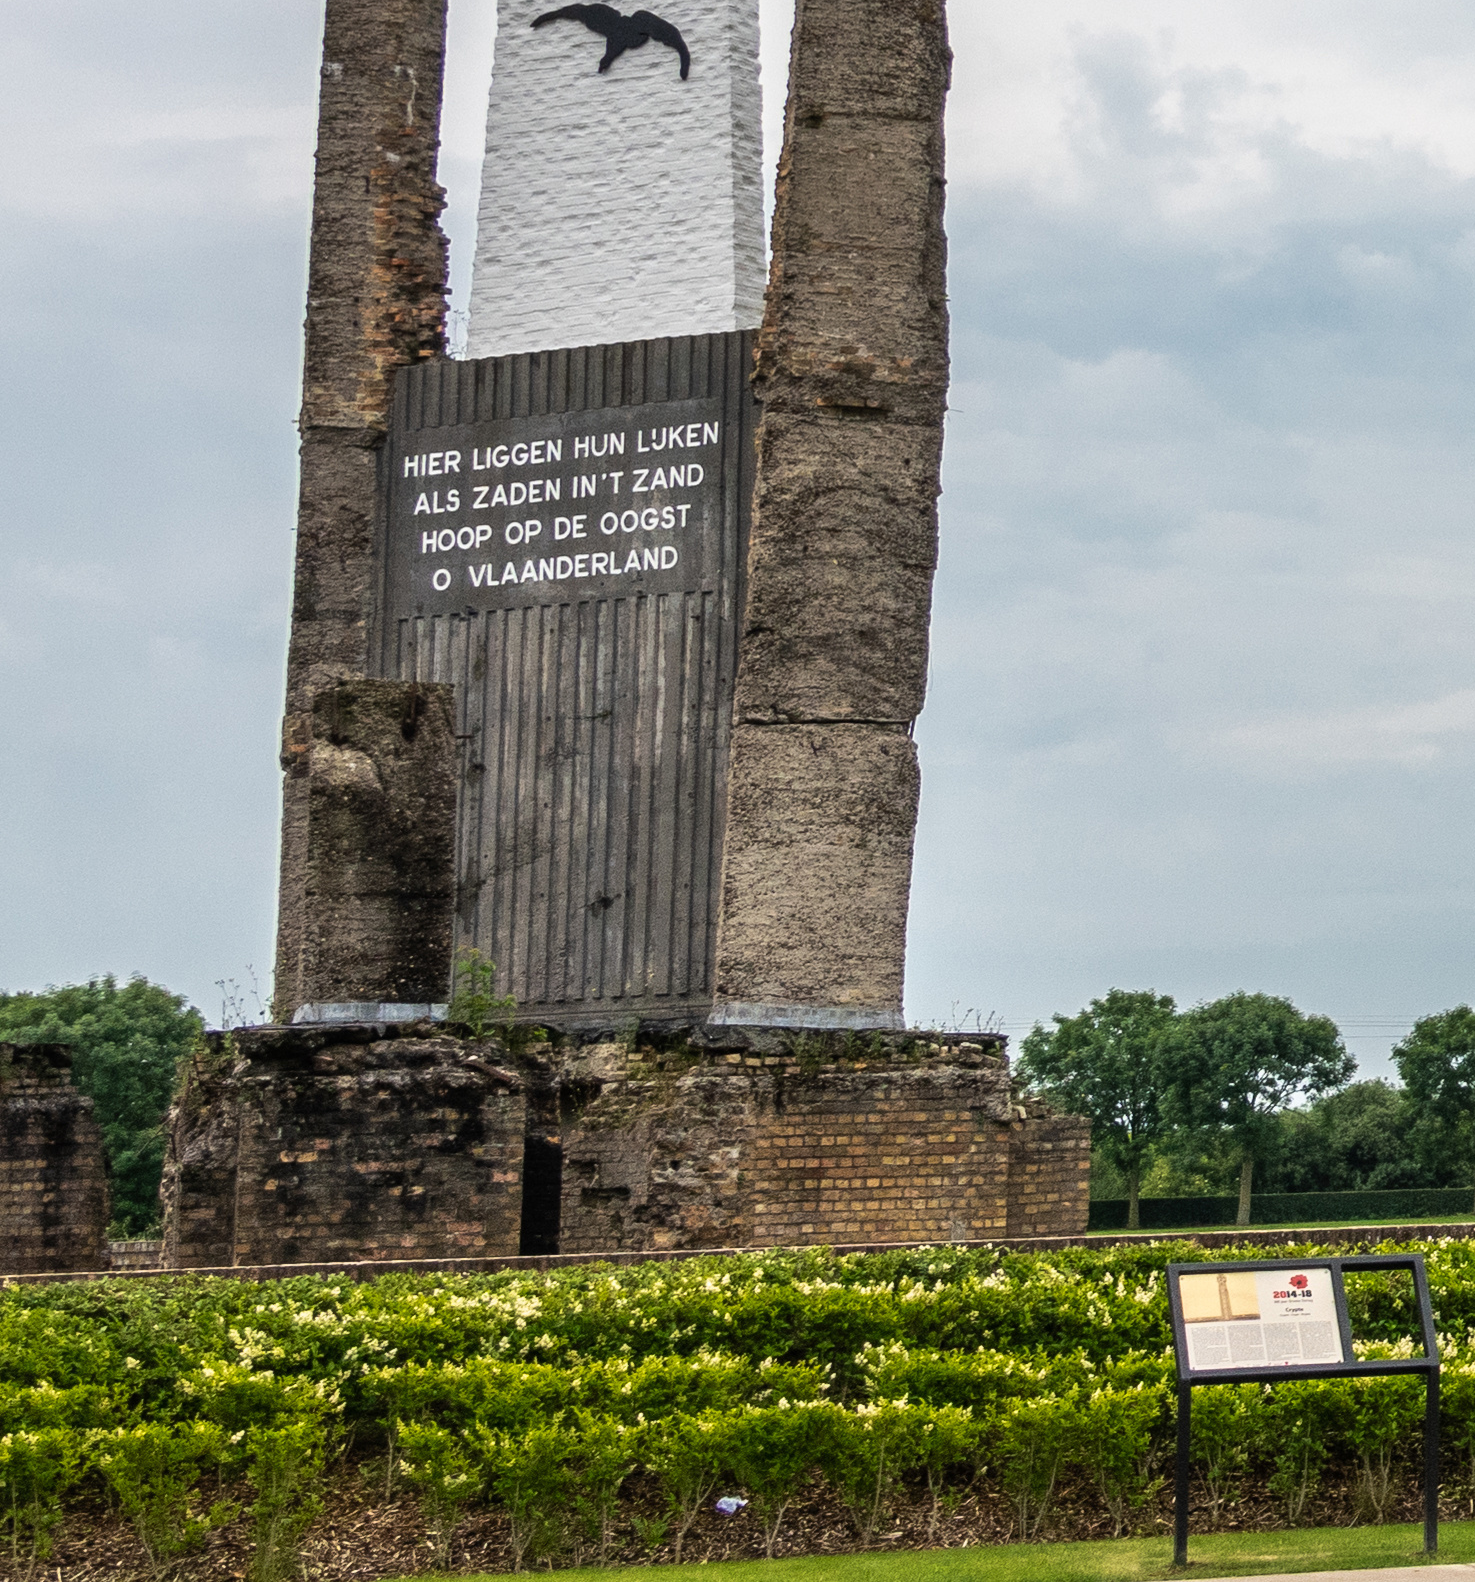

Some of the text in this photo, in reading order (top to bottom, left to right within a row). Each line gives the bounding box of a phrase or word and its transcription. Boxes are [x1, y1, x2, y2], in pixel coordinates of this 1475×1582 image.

[403, 450, 462, 478] HIER
[472, 438, 563, 471] LIGGEN
[574, 432, 626, 460] HUN
[413, 489, 461, 516] ALS
[472, 477, 561, 509] ZADEN
[632, 463, 705, 493] ZAND
[421, 503, 693, 554] HOOP OP DE OOGST
[432, 545, 679, 591] O VLAANDERLAND
[1273, 1290, 1312, 1298] 2014-18
